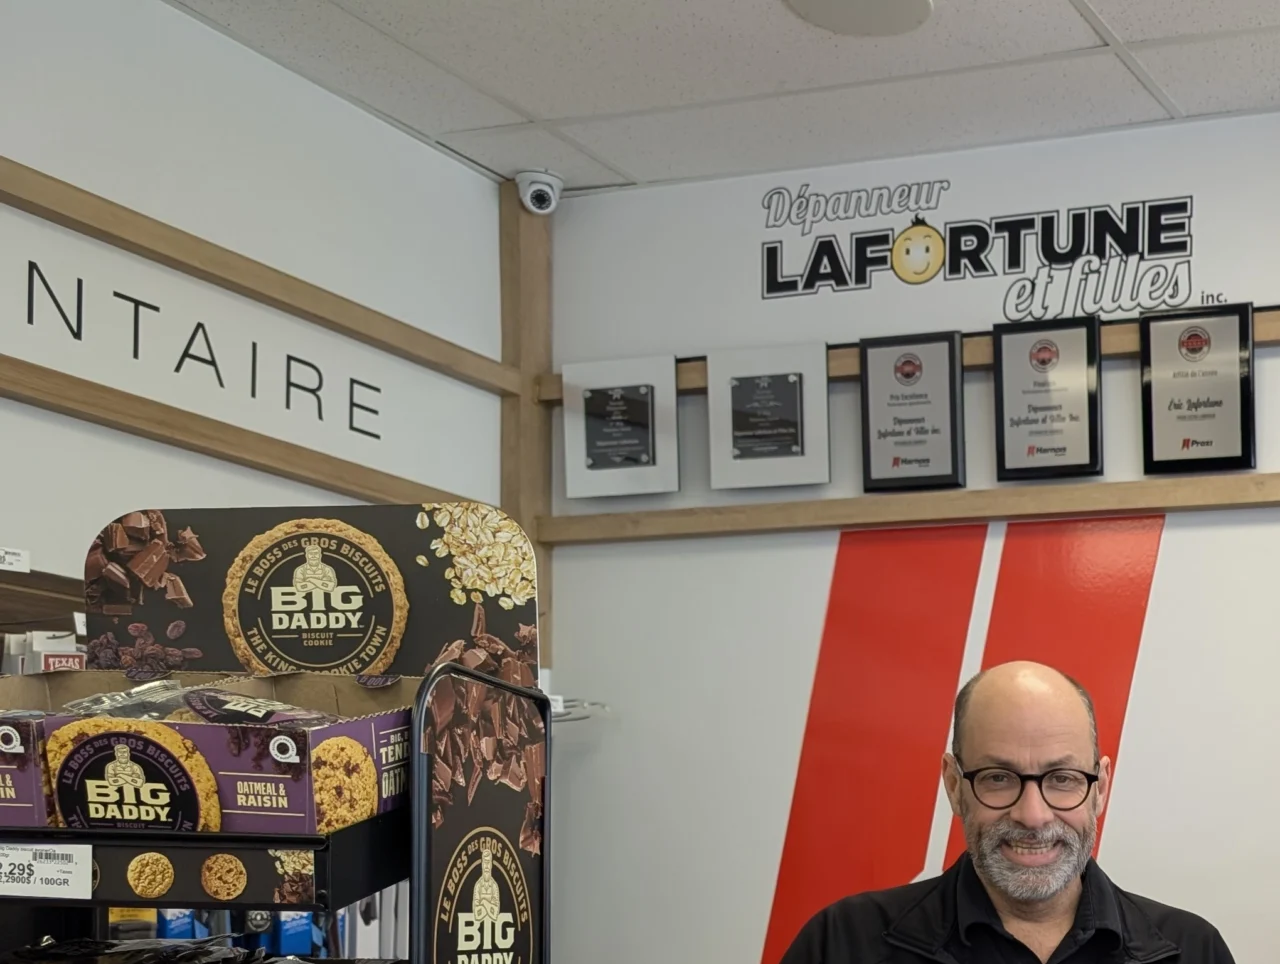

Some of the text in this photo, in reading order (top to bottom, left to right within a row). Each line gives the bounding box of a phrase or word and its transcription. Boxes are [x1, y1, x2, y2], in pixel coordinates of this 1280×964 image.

[762, 180, 950, 236] Dépanneur
[762, 196, 1193, 299] LAFORTUNE
[1003, 255, 1228, 321] et filles inc.
[27, 259, 383, 441] NTAIRE
[245, 537, 386, 594] LE BOSS DES GROS BISCUITS
[270, 585, 364, 611] BIG
[271, 612, 364, 630] DADDY
[247, 627, 267, 653] THE
[359, 625, 388, 662] TOWN
[85, 779, 171, 806] BIG
[236, 781, 286, 796] OATMEAL &
[236, 794, 288, 808] RAISIN
[88, 802, 172, 821] DADDY
[40, 877, 70, 886] 100GR
[457, 912, 515, 951] BIG
